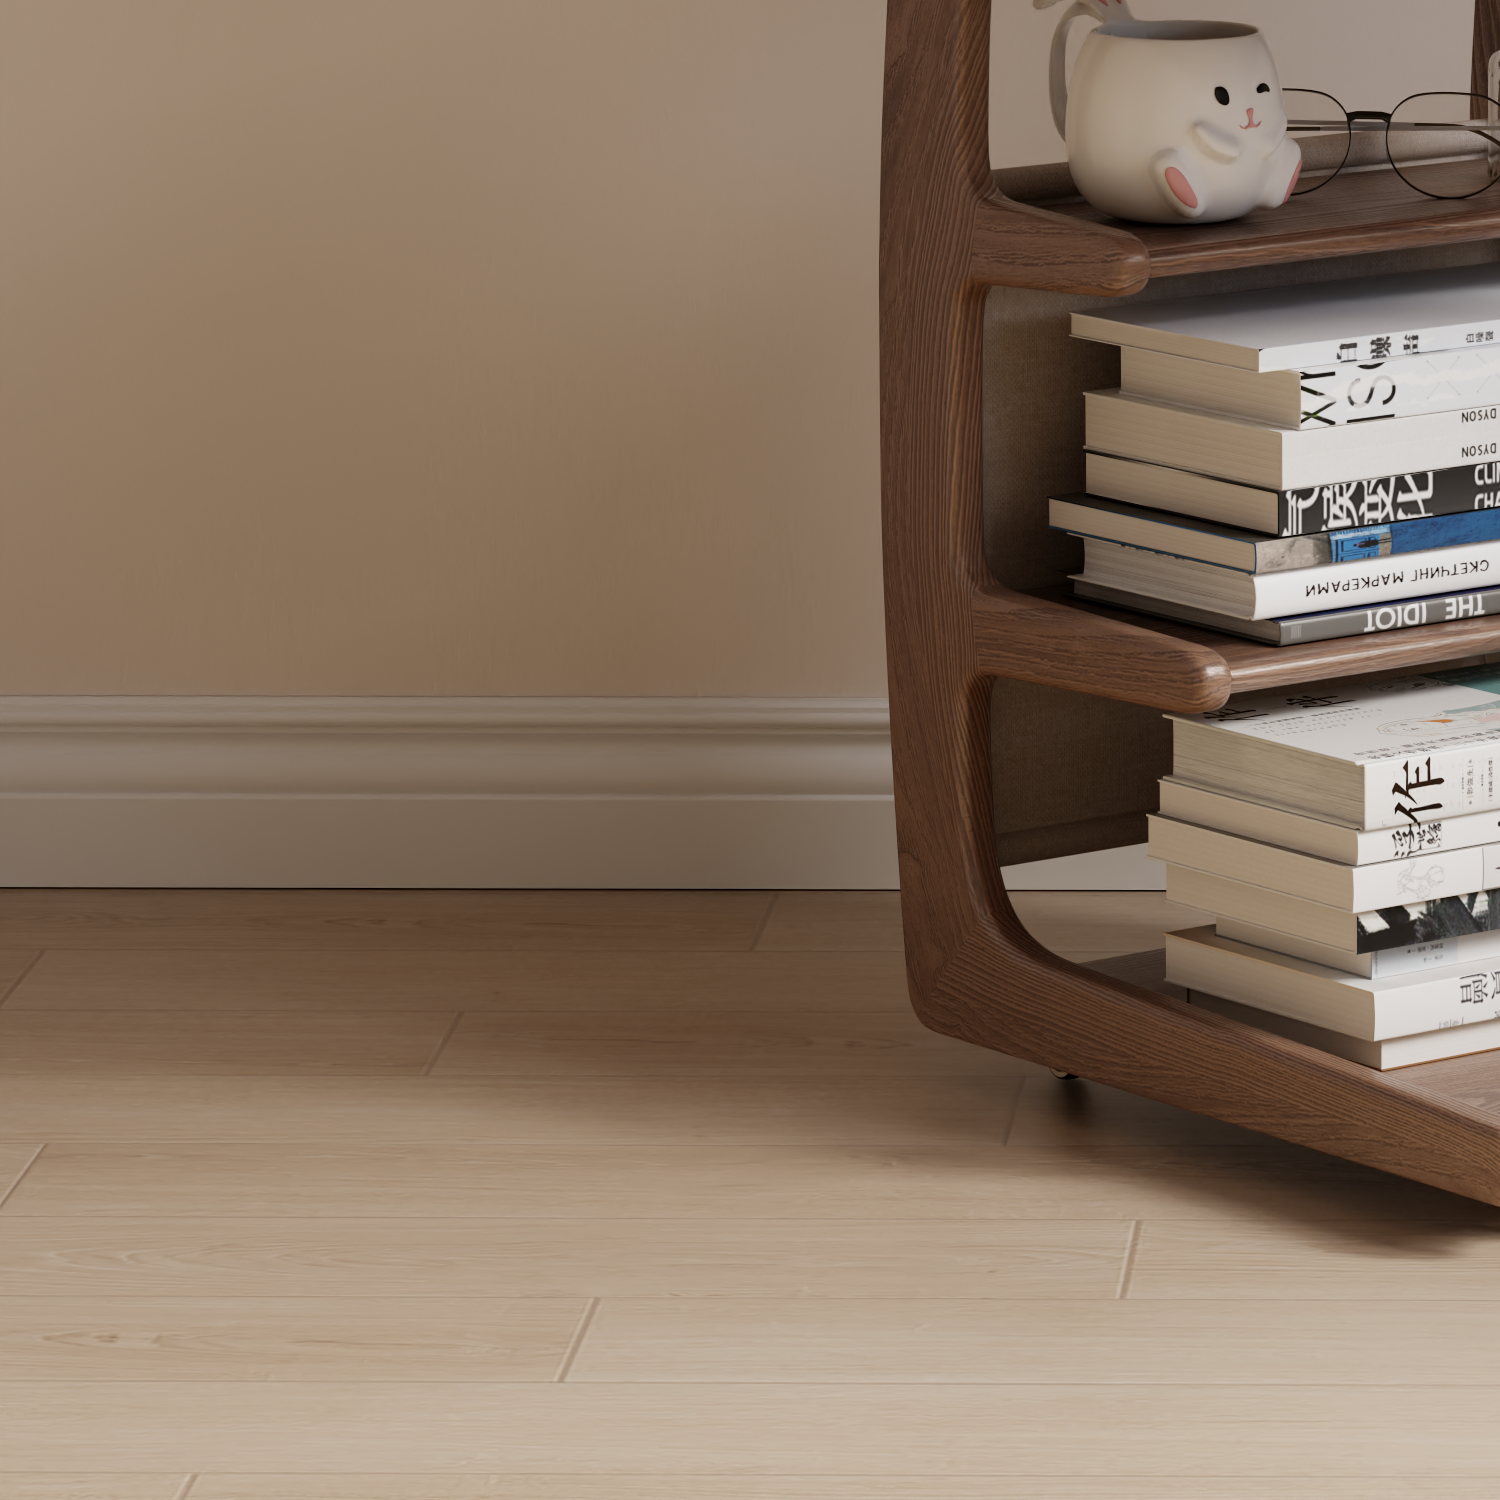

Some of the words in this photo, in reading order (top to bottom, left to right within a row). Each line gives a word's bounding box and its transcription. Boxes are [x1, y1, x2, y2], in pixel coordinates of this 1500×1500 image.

[1461, 408, 1497, 423] DYSON
[1461, 442, 1497, 458] DYSON
[1410, 559, 1490, 582] СКЕТЧИНГ
[1305, 571, 1404, 597] МАРКЕРАМИ
[1364, 602, 1427, 632] IDIOT
[1445, 593, 1486, 620] THE
[1391, 756, 1445, 823] 作
